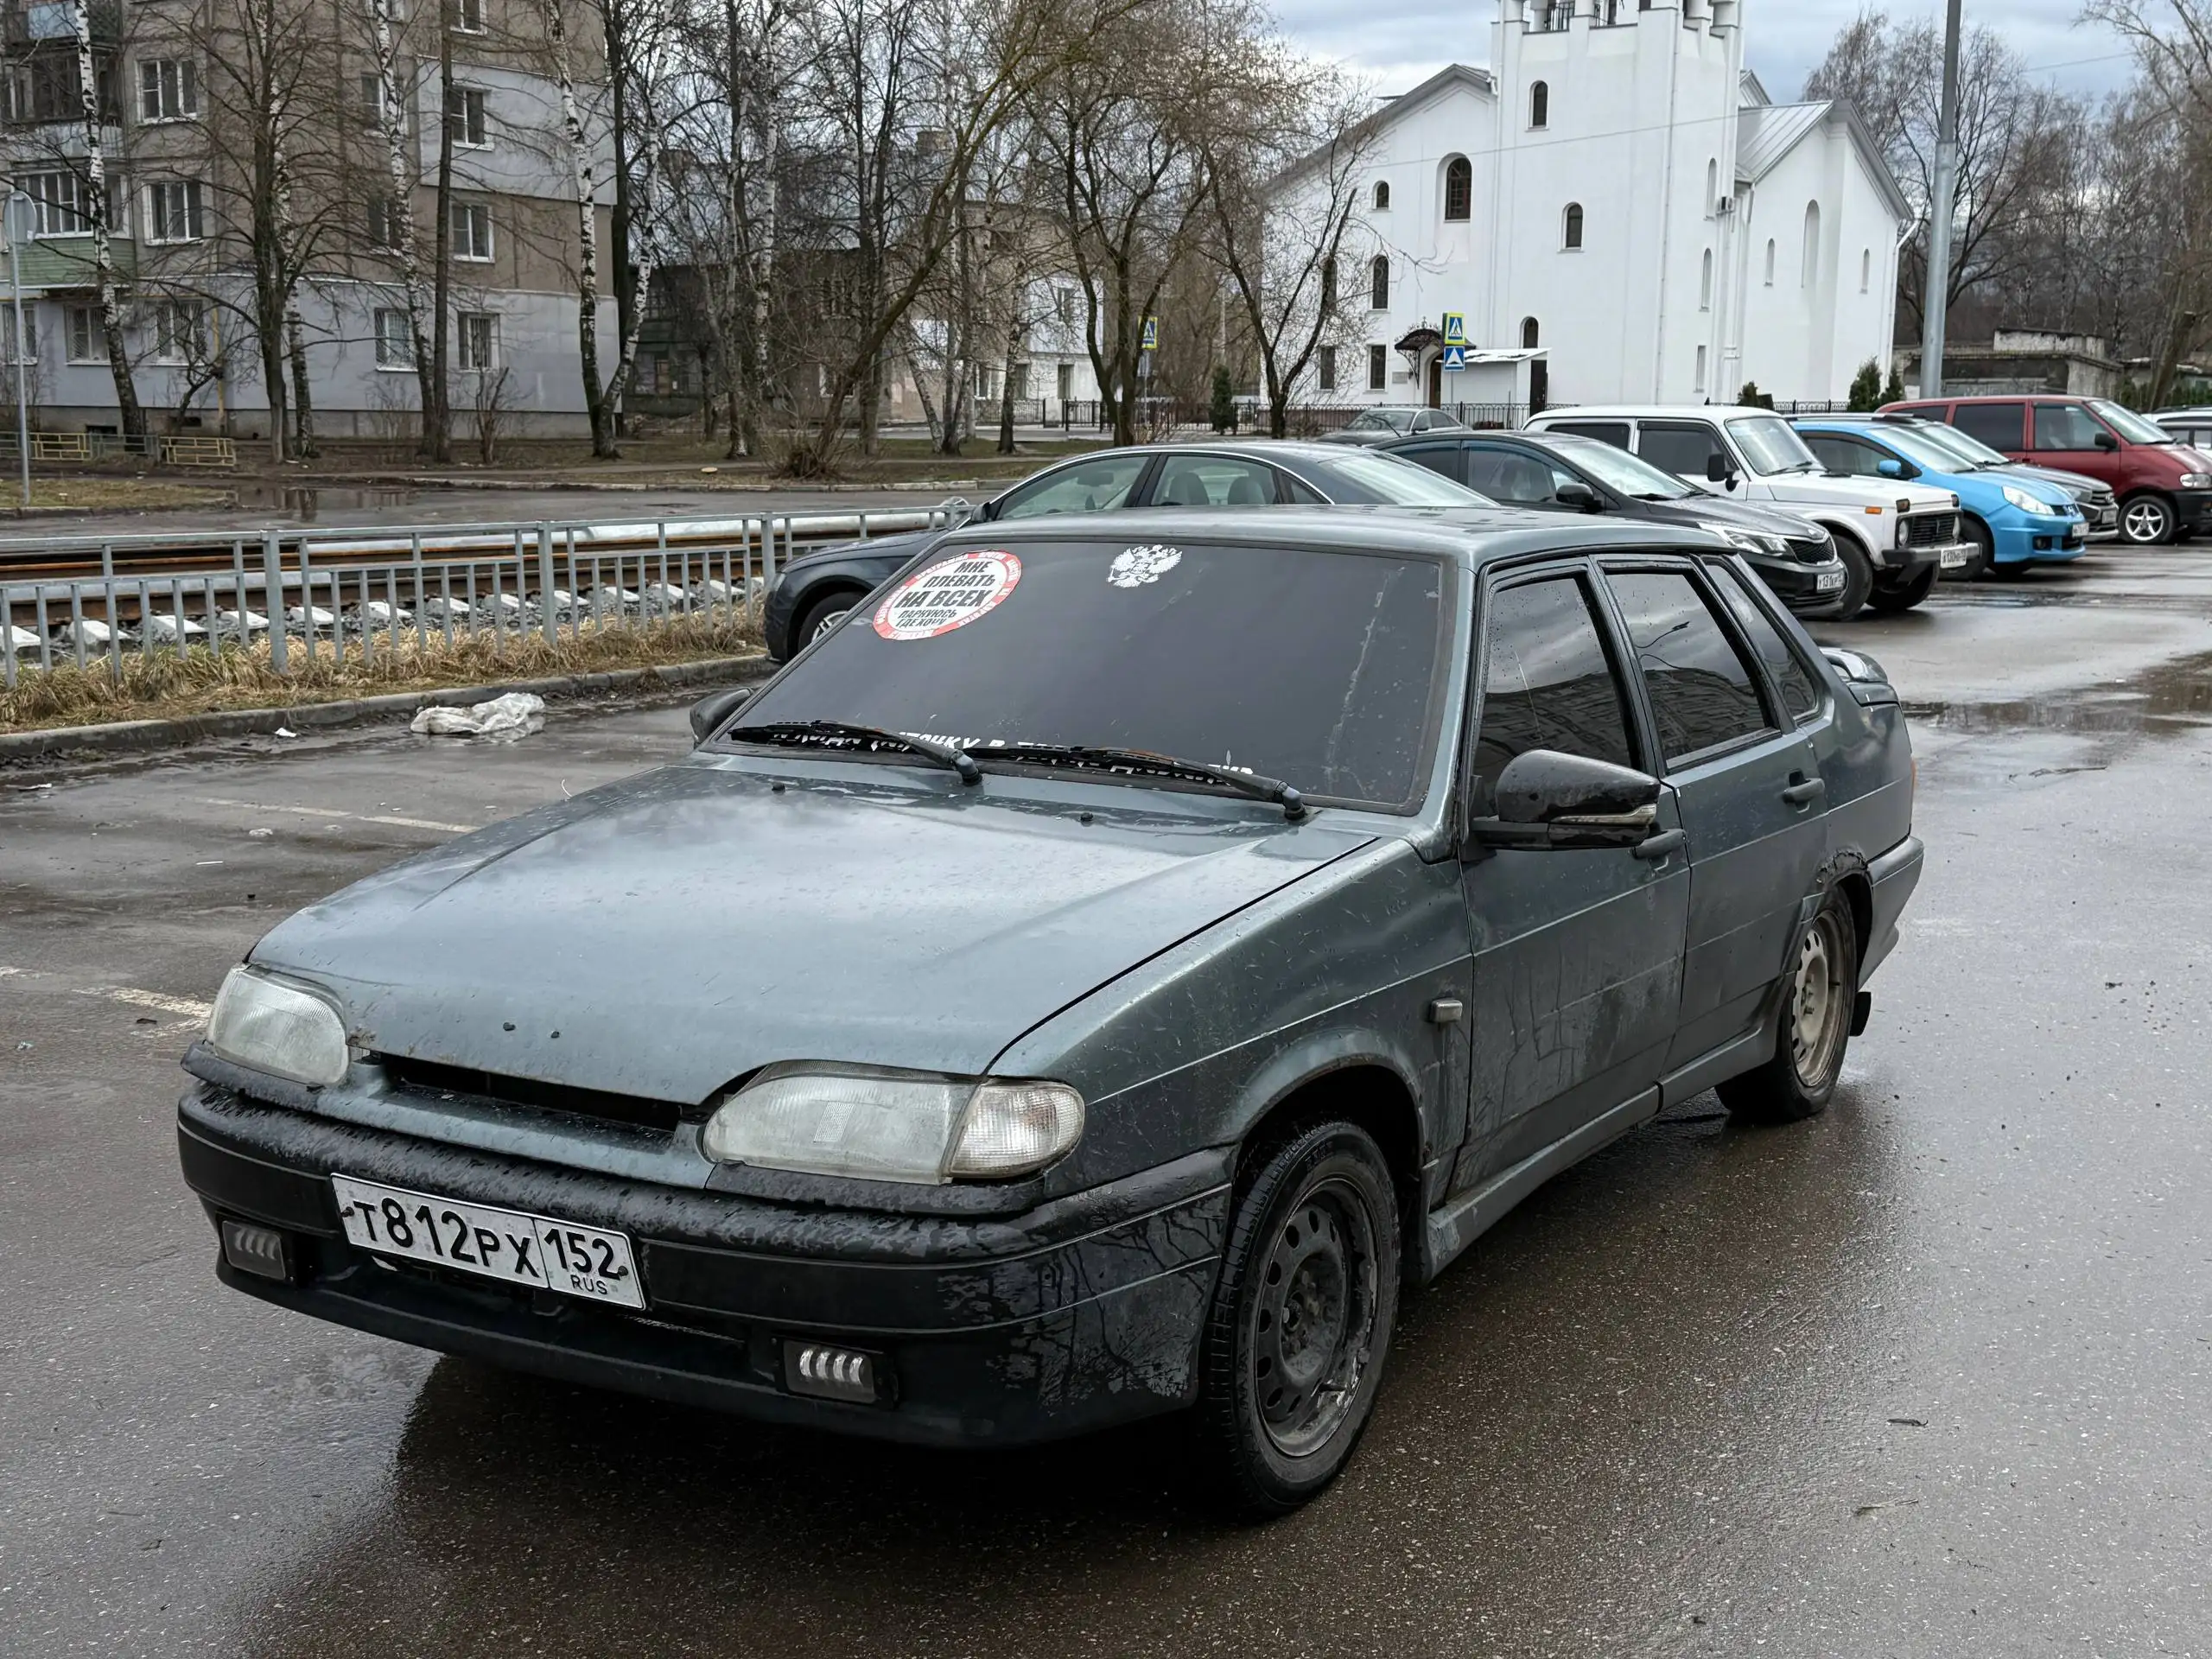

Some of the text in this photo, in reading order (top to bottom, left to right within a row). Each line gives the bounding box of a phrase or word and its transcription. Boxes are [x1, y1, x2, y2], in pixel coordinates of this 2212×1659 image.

[953, 561, 993, 573] МНЕ
[922, 575, 996, 588] ПЛЕВАТЬ
[894, 590, 929, 608] НА
[928, 589, 993, 607] ВСЕХ
[353, 1197, 621, 1281] Т812РХ 152
[570, 1274, 608, 1295] RUS
